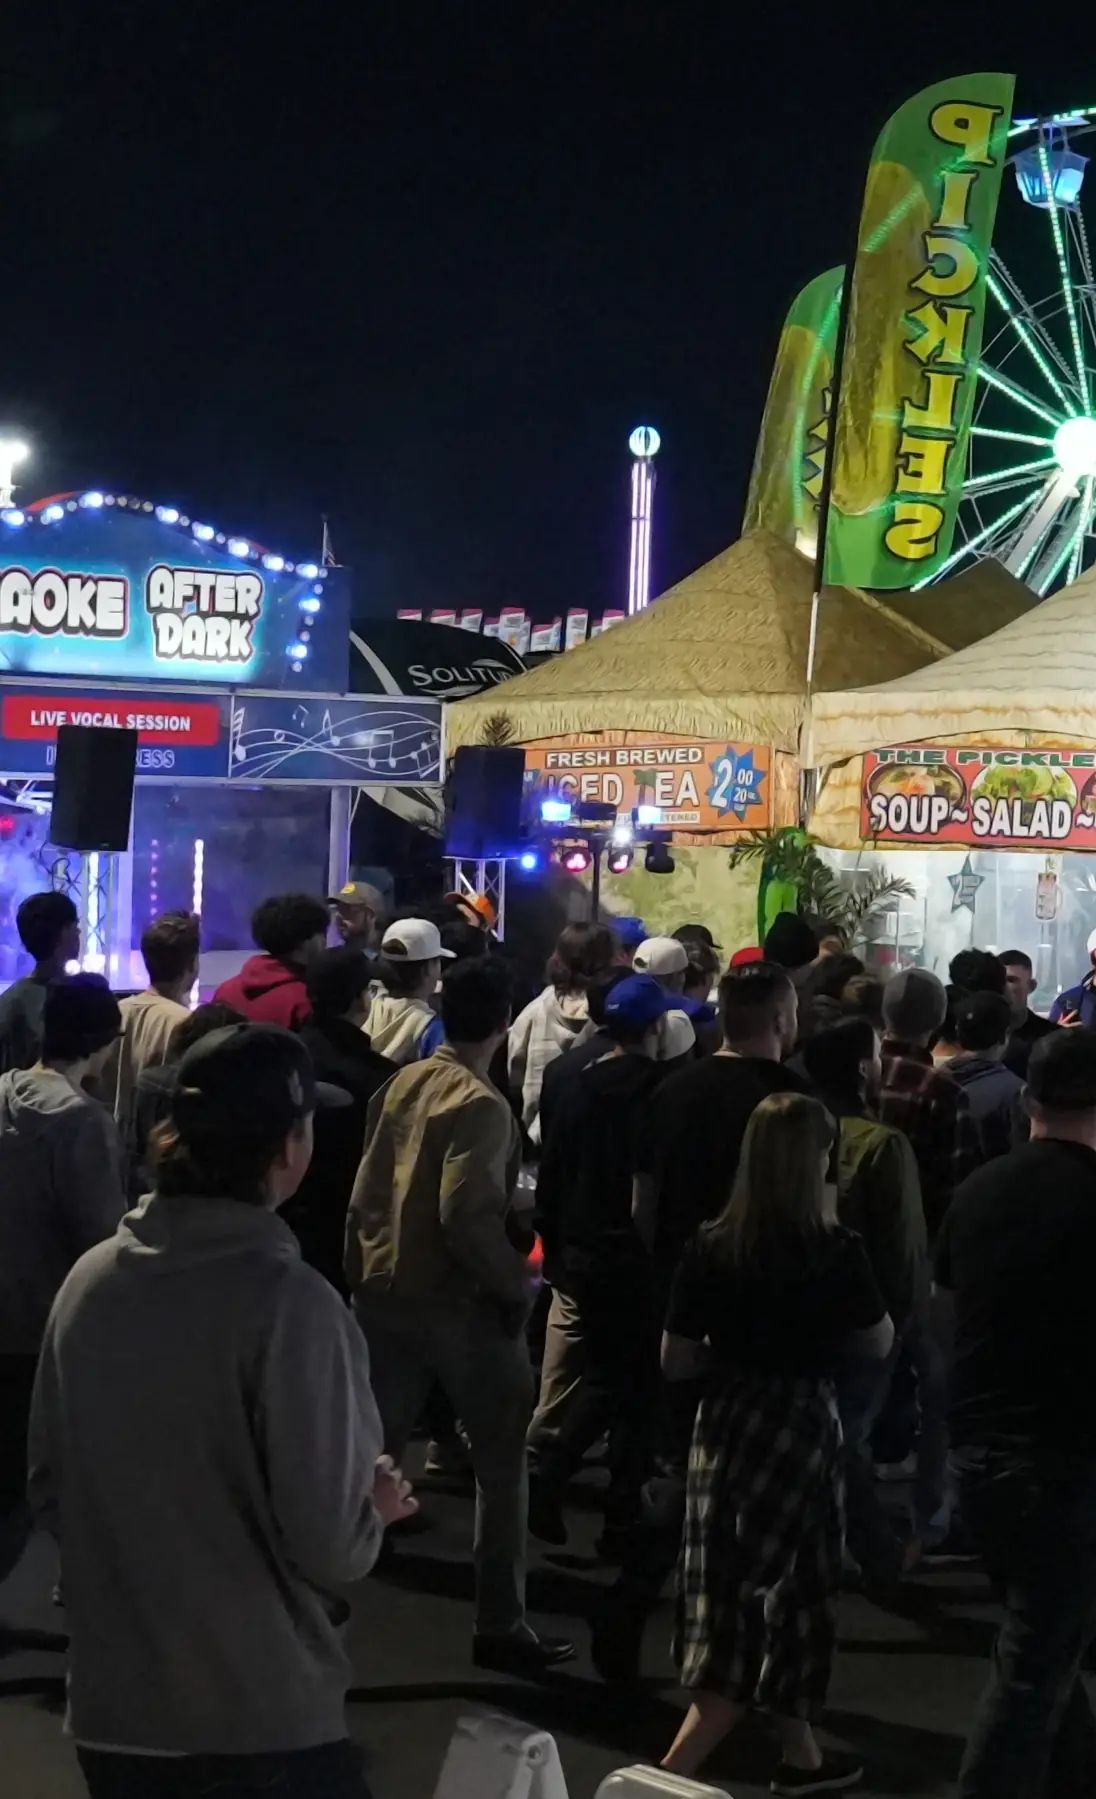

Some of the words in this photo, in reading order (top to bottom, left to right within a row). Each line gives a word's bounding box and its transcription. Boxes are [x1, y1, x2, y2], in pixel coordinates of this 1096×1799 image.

[148, 567, 263, 616] AFTER
[155, 613, 252, 658] DARK
[31, 709, 67, 726] LIVE
[72, 711, 122, 728] VOCAL
[126, 713, 191, 731] SESSION
[546, 751, 610, 768] FRESH
[615, 747, 702, 766] BREWED
[875, 749, 948, 765] THE
[870, 793, 950, 833] SOUP
[971, 796, 1073, 839] SALAD
